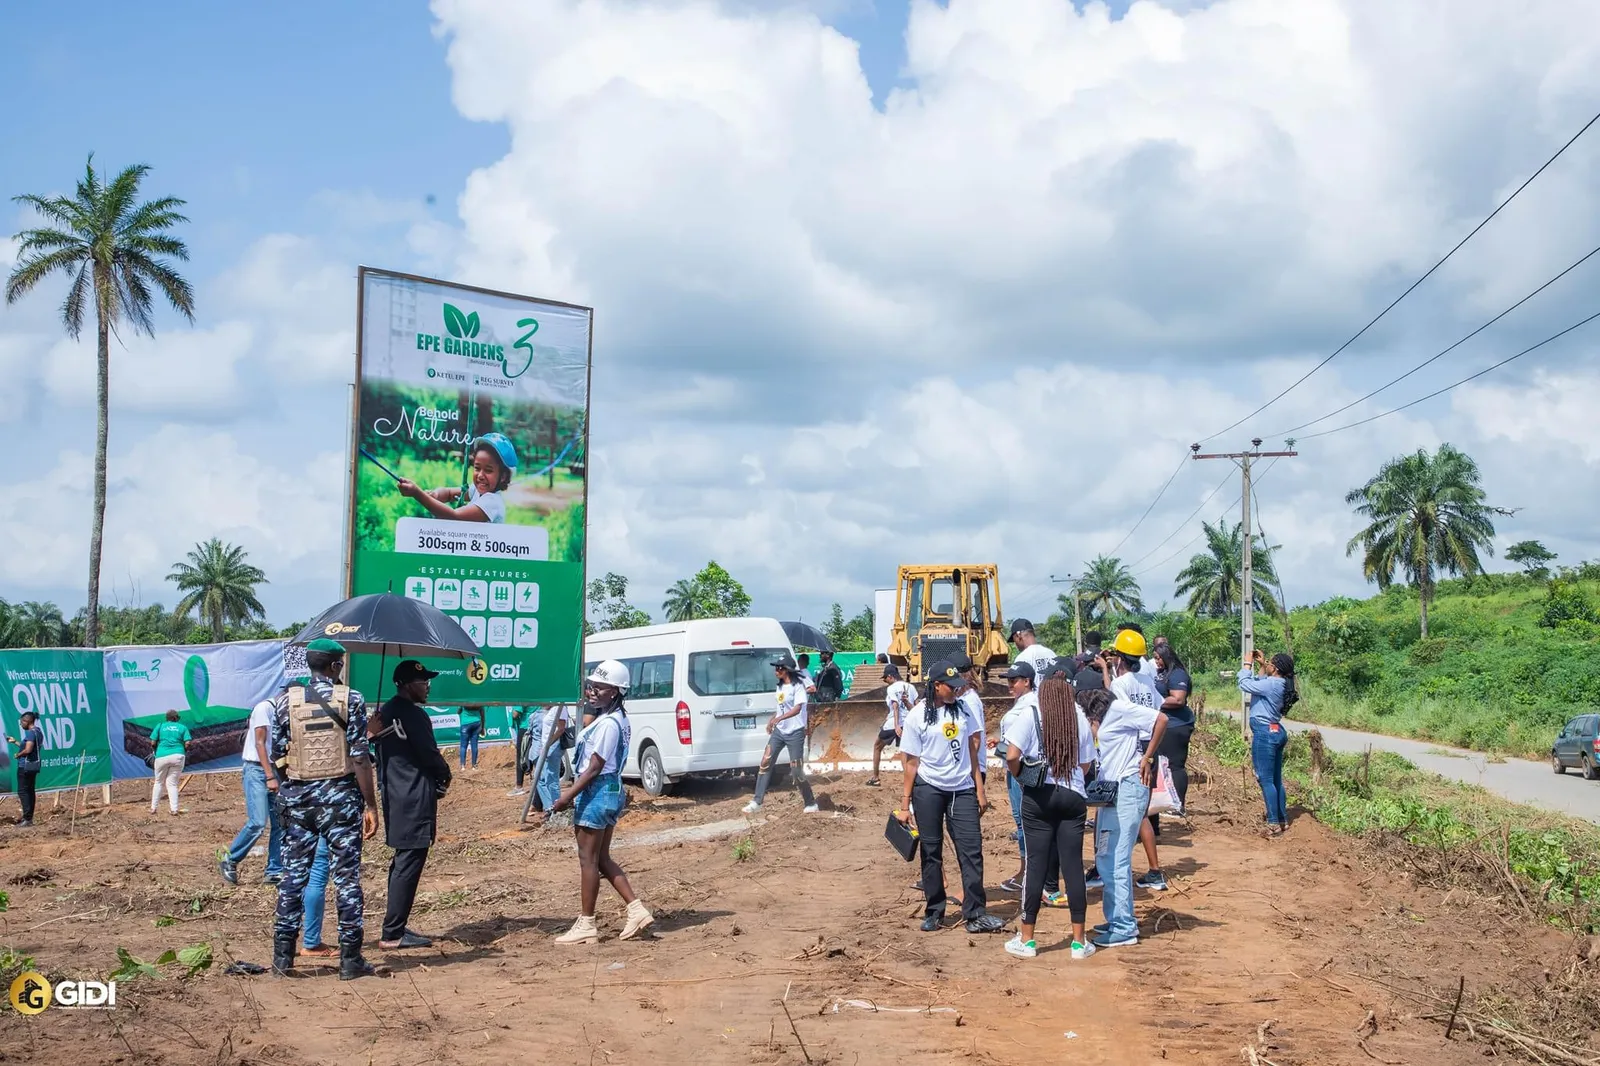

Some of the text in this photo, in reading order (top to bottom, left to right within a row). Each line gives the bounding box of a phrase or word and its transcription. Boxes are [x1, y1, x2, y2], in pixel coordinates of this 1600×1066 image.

[417, 318, 539, 378] EPE GARDENS 3
[493, 378, 515, 387] SURVEY
[419, 406, 459, 420] Behold
[374, 406, 475, 445] Nature
[419, 528, 489, 540] Available square meters
[418, 536, 530, 557] 300sqm & 500sqm
[420, 566, 527, 579] ESTATE FEATURES
[7, 669, 88, 682] When they say you can't
[490, 663, 520, 679] GIDI
[13, 683, 91, 715] OWN A
[50, 755, 61, 767] and
[61, 754, 74, 766] take
